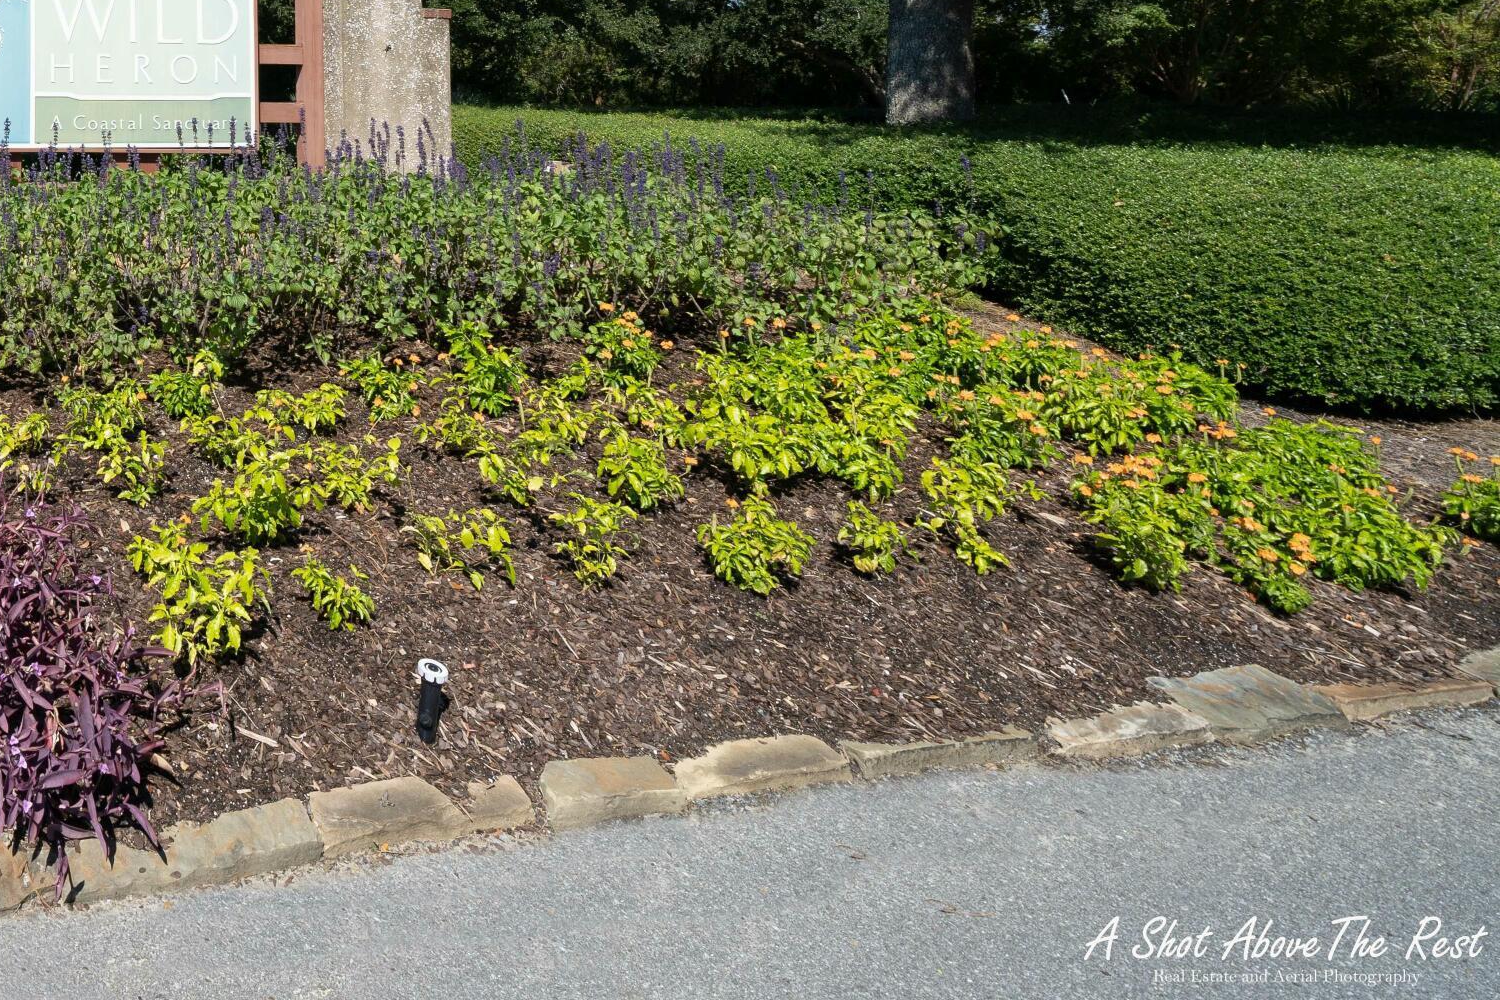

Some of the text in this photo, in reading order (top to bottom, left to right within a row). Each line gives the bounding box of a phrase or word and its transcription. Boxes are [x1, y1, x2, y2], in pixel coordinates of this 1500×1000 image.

[50, 53, 238, 84] HERON
[50, 113, 238, 133] A Coastal Sancuar
